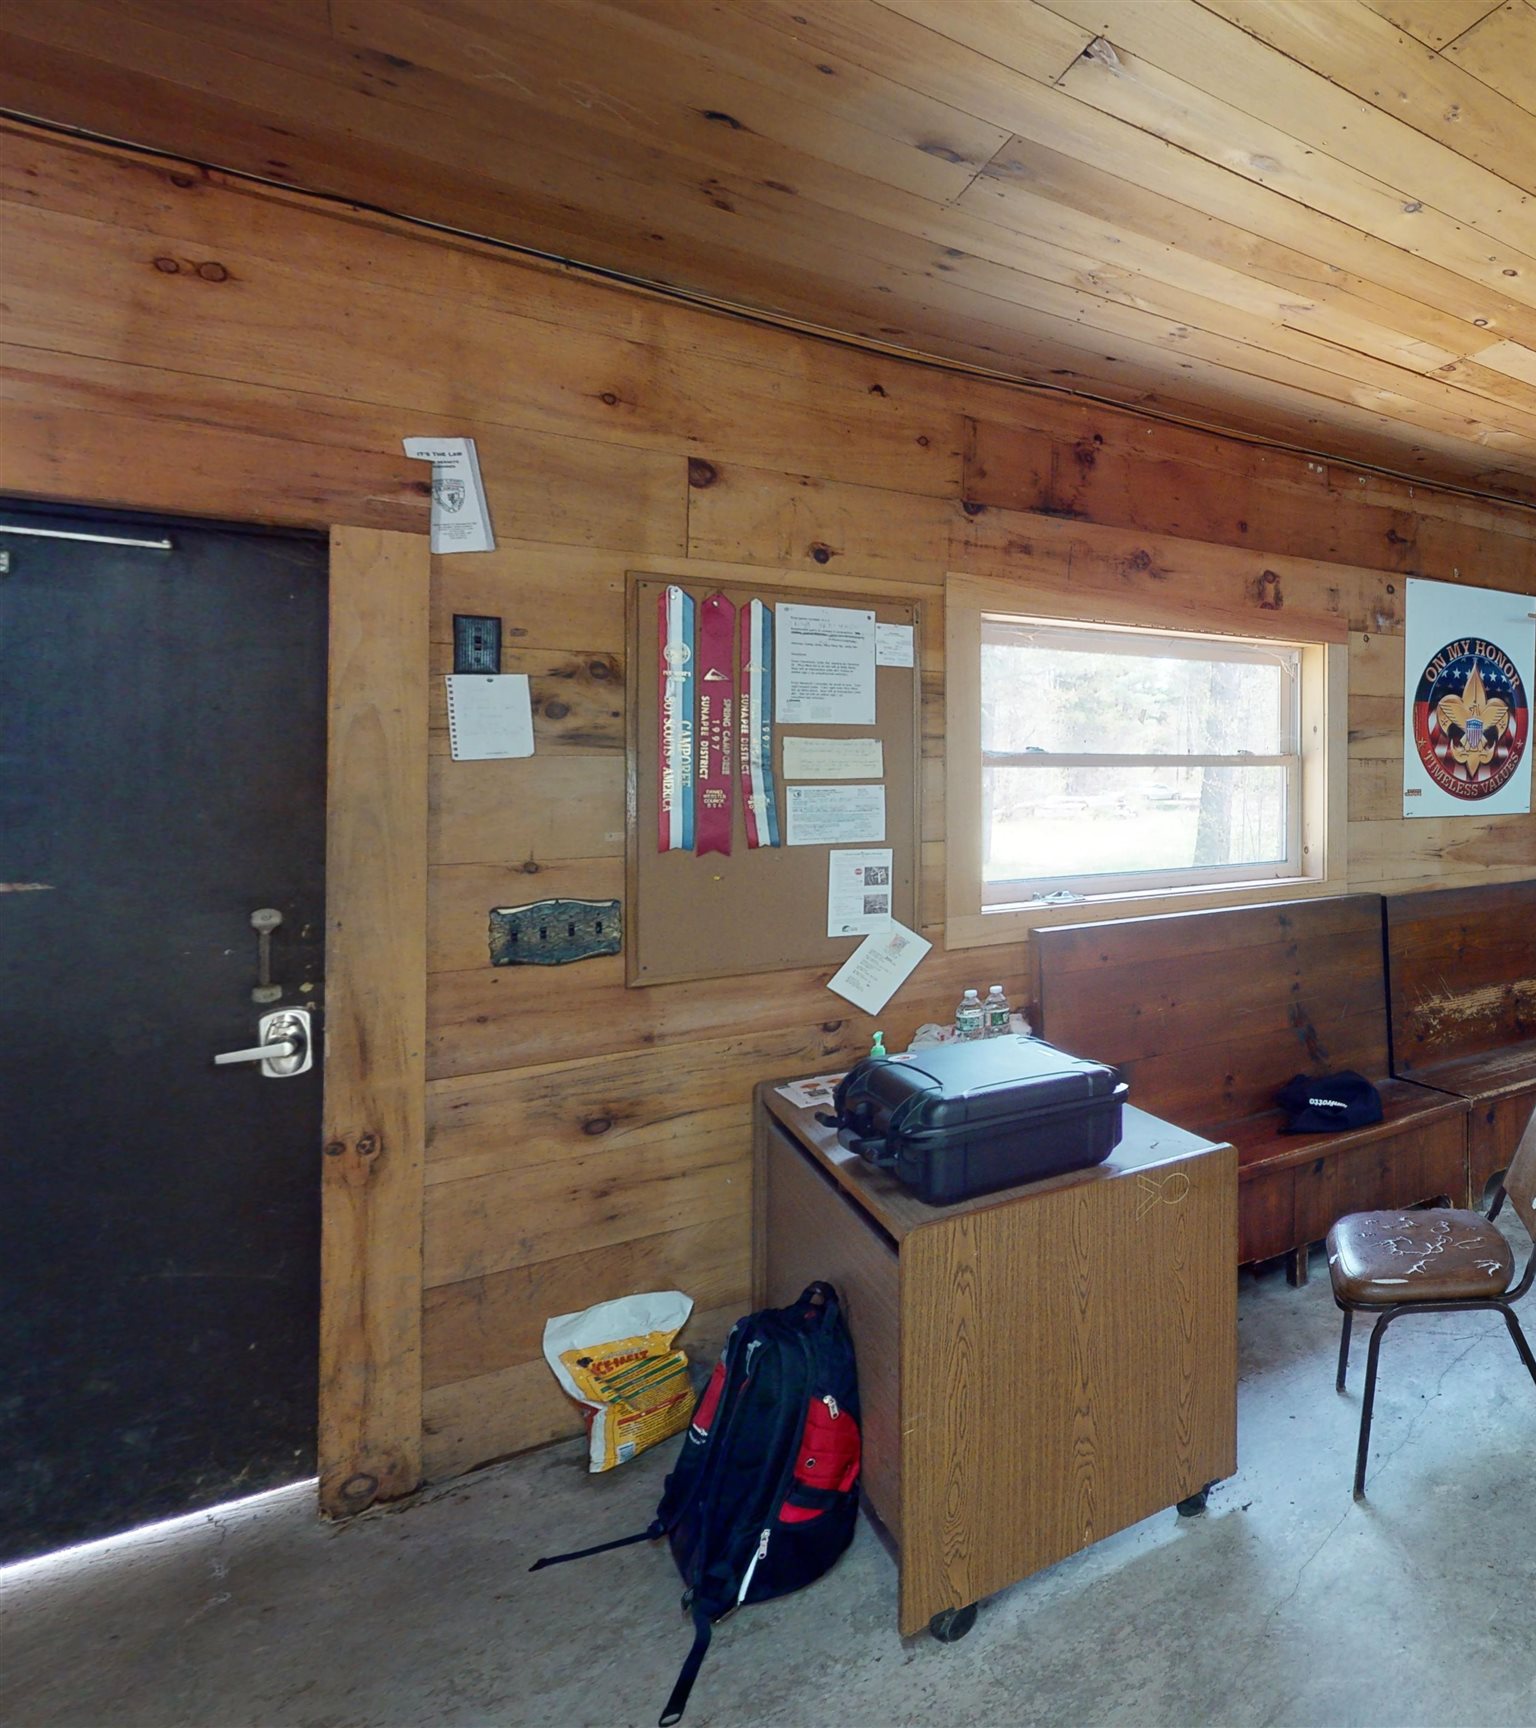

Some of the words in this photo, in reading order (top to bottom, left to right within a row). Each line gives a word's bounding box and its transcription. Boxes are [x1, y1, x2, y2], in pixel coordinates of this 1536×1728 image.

[1425, 653, 1447, 683] ON
[1446, 640, 1470, 661] MY
[1475, 640, 1520, 690] HONOR
[700, 695, 710, 737] SUNAPEE
[723, 698, 732, 727] SPRING
[740, 693, 750, 734] SUNAPEE
[663, 718, 673, 757] SCOUTS
[680, 720, 692, 788] CAMPOREE
[711, 719, 720, 751] 1997
[762, 719, 770, 749] 1997
[699, 740, 710, 780] DISTRICT
[740, 737, 750, 776] DISTRICT
[1424, 750, 1479, 796] TIMELESS
[1480, 752, 1519, 793] VALUES
[662, 766, 674, 812] AMERICA
